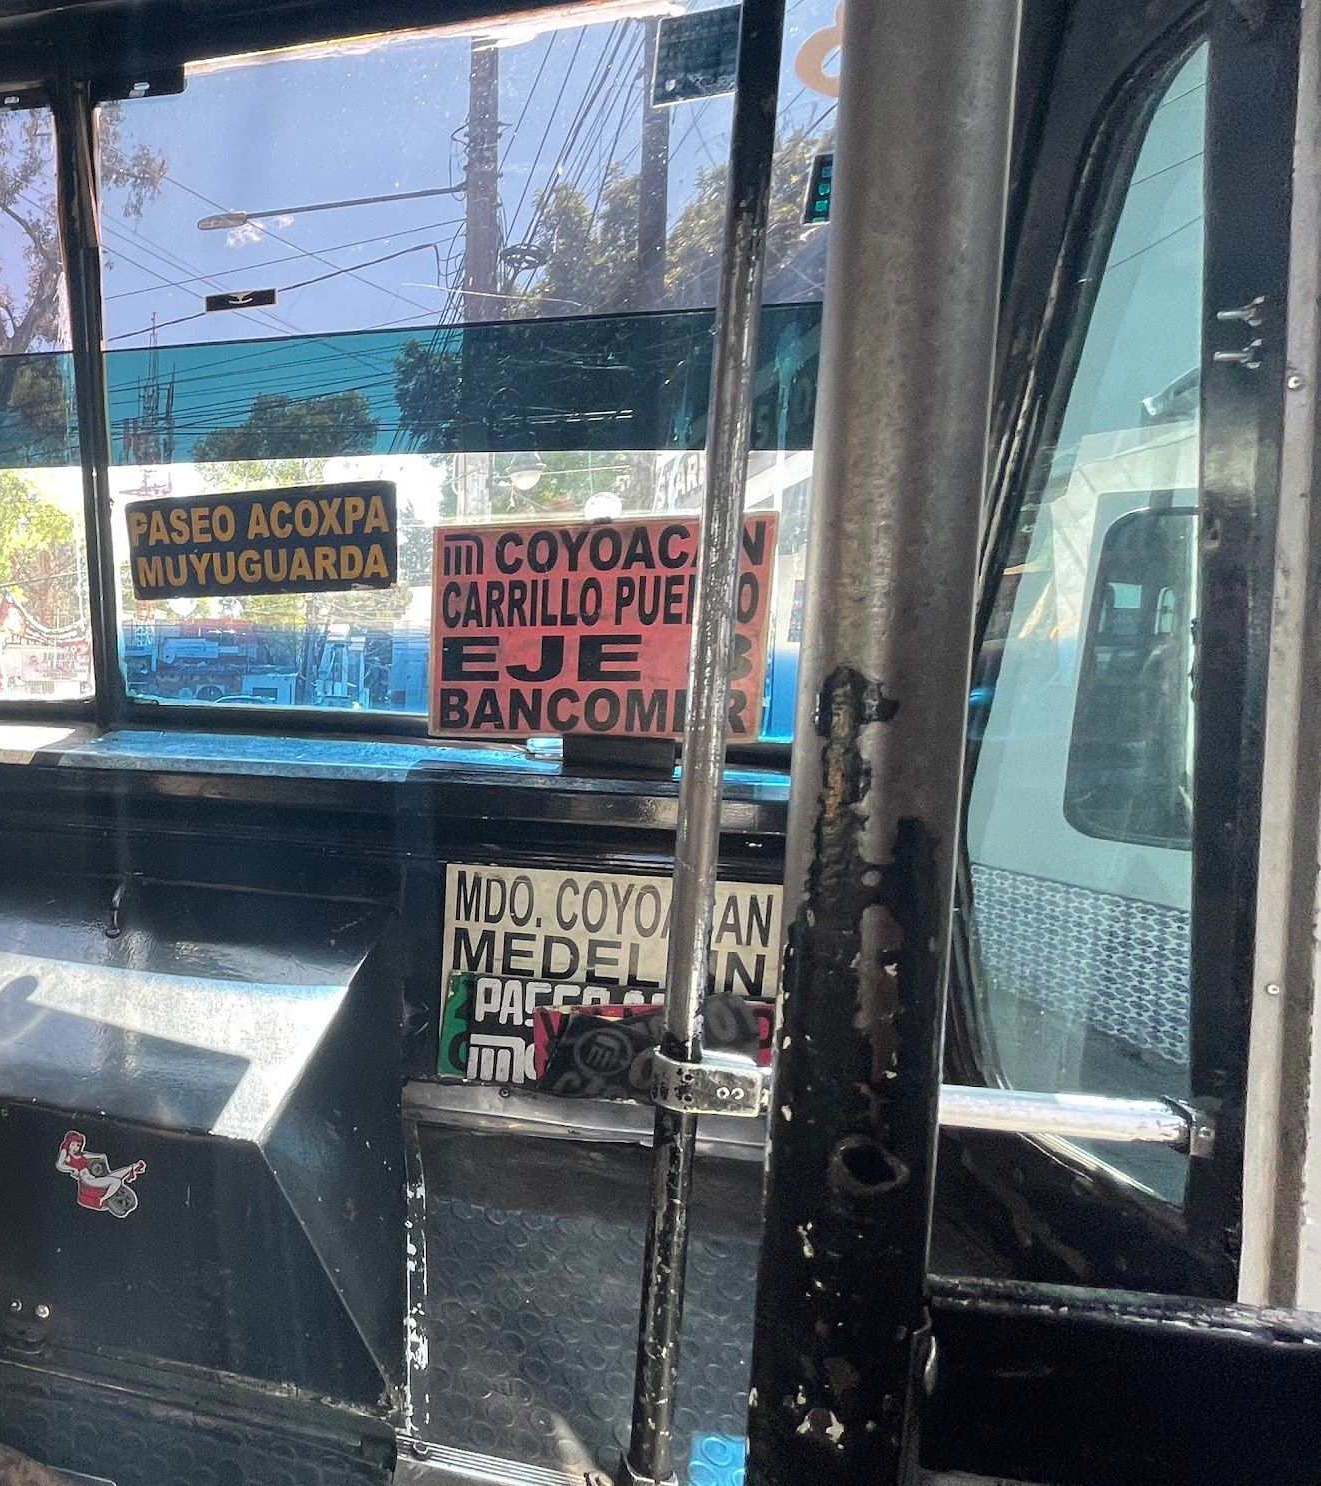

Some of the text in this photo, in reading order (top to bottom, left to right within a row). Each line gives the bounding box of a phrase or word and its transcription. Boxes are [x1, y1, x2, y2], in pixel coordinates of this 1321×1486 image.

[130, 495, 389, 547] PASEO ACOXPA
[495, 520, 767, 575] COYOACN
[136, 544, 390, 588] MUYUGUARDA
[442, 571, 760, 629] CARRILLO PUEO
[441, 634, 643, 682] EJE
[455, 870, 775, 948] MDO. COYOAN
[452, 927, 766, 996] MEDELIN
